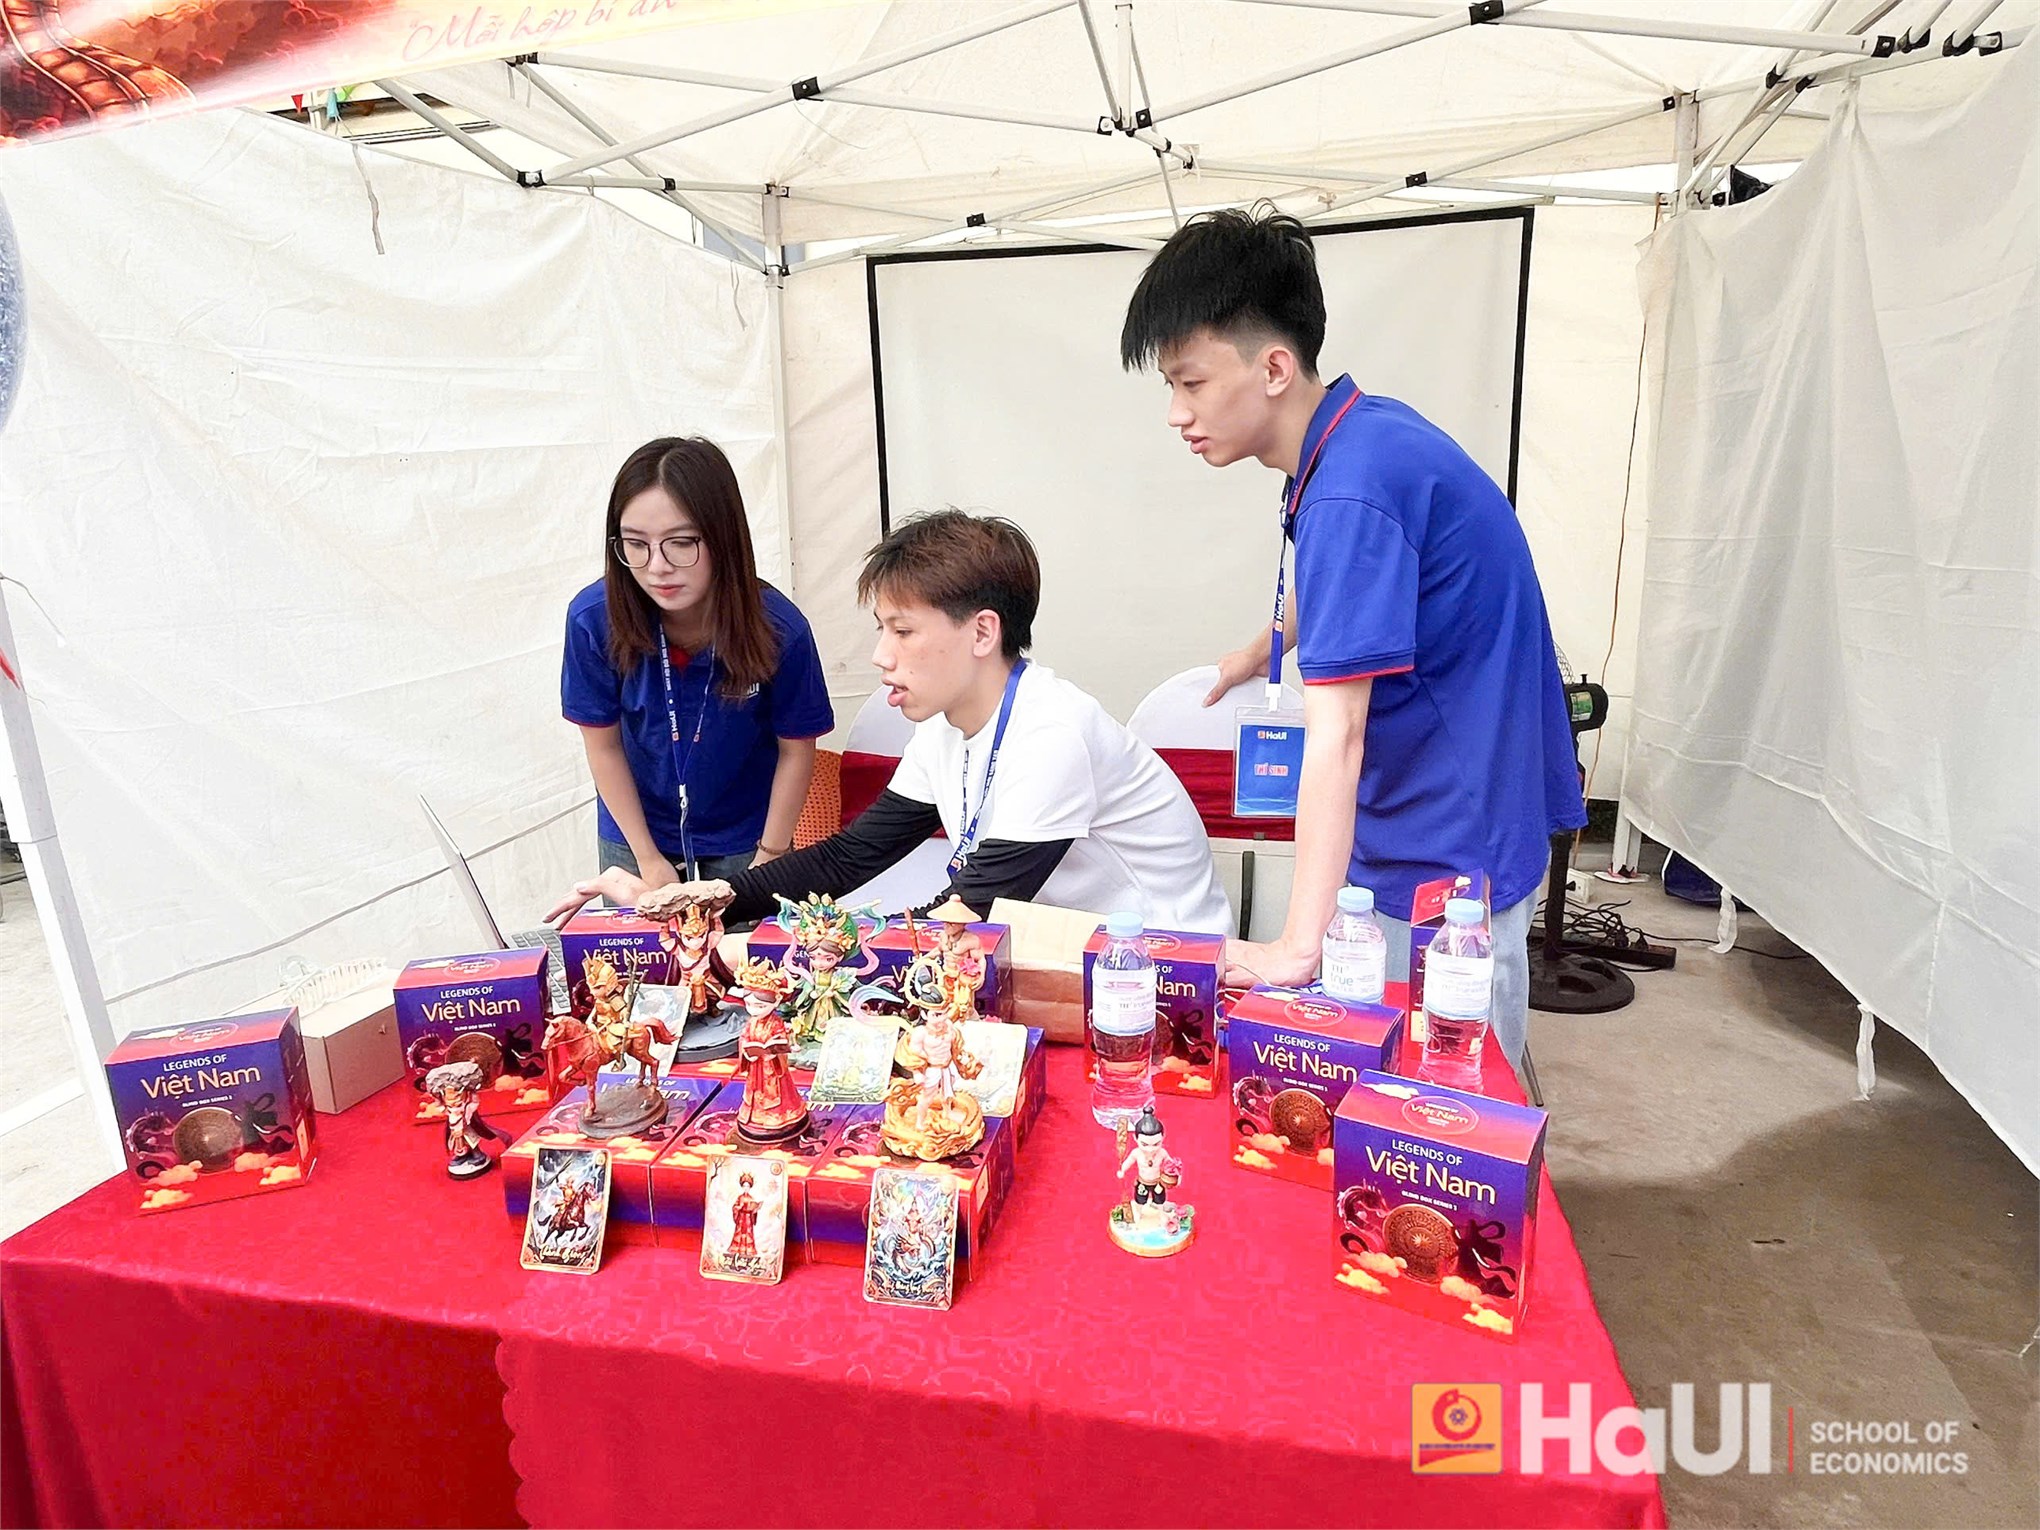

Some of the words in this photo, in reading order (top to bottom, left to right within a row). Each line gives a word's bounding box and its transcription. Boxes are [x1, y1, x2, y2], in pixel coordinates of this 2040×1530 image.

[1265, 731, 1287, 740] HaUI
[599, 937, 633, 947] LEGENDS
[634, 937, 644, 945] OF
[622, 947, 667, 966] Nam
[1161, 965, 1173, 974] OF
[440, 987, 480, 999] LEGENDS
[481, 985, 494, 994] OF
[421, 1000, 465, 1024] Việt
[468, 997, 521, 1018] Nam
[1273, 1033, 1317, 1050] LEGENDS
[1317, 1042, 1331, 1053] OF
[163, 1056, 212, 1072] LEGENDS
[212, 1053, 228, 1064] OF
[1252, 1041, 1298, 1073] Việt
[1301, 1051, 1358, 1083] Nam
[140, 1073, 195, 1100] Việt
[197, 1066, 261, 1091] Nam
[1391, 1139, 1444, 1162] LEGENDS
[1446, 1153, 1463, 1166] OF
[1365, 1145, 1420, 1184] Việt
[1425, 1162, 1497, 1205] Nam
